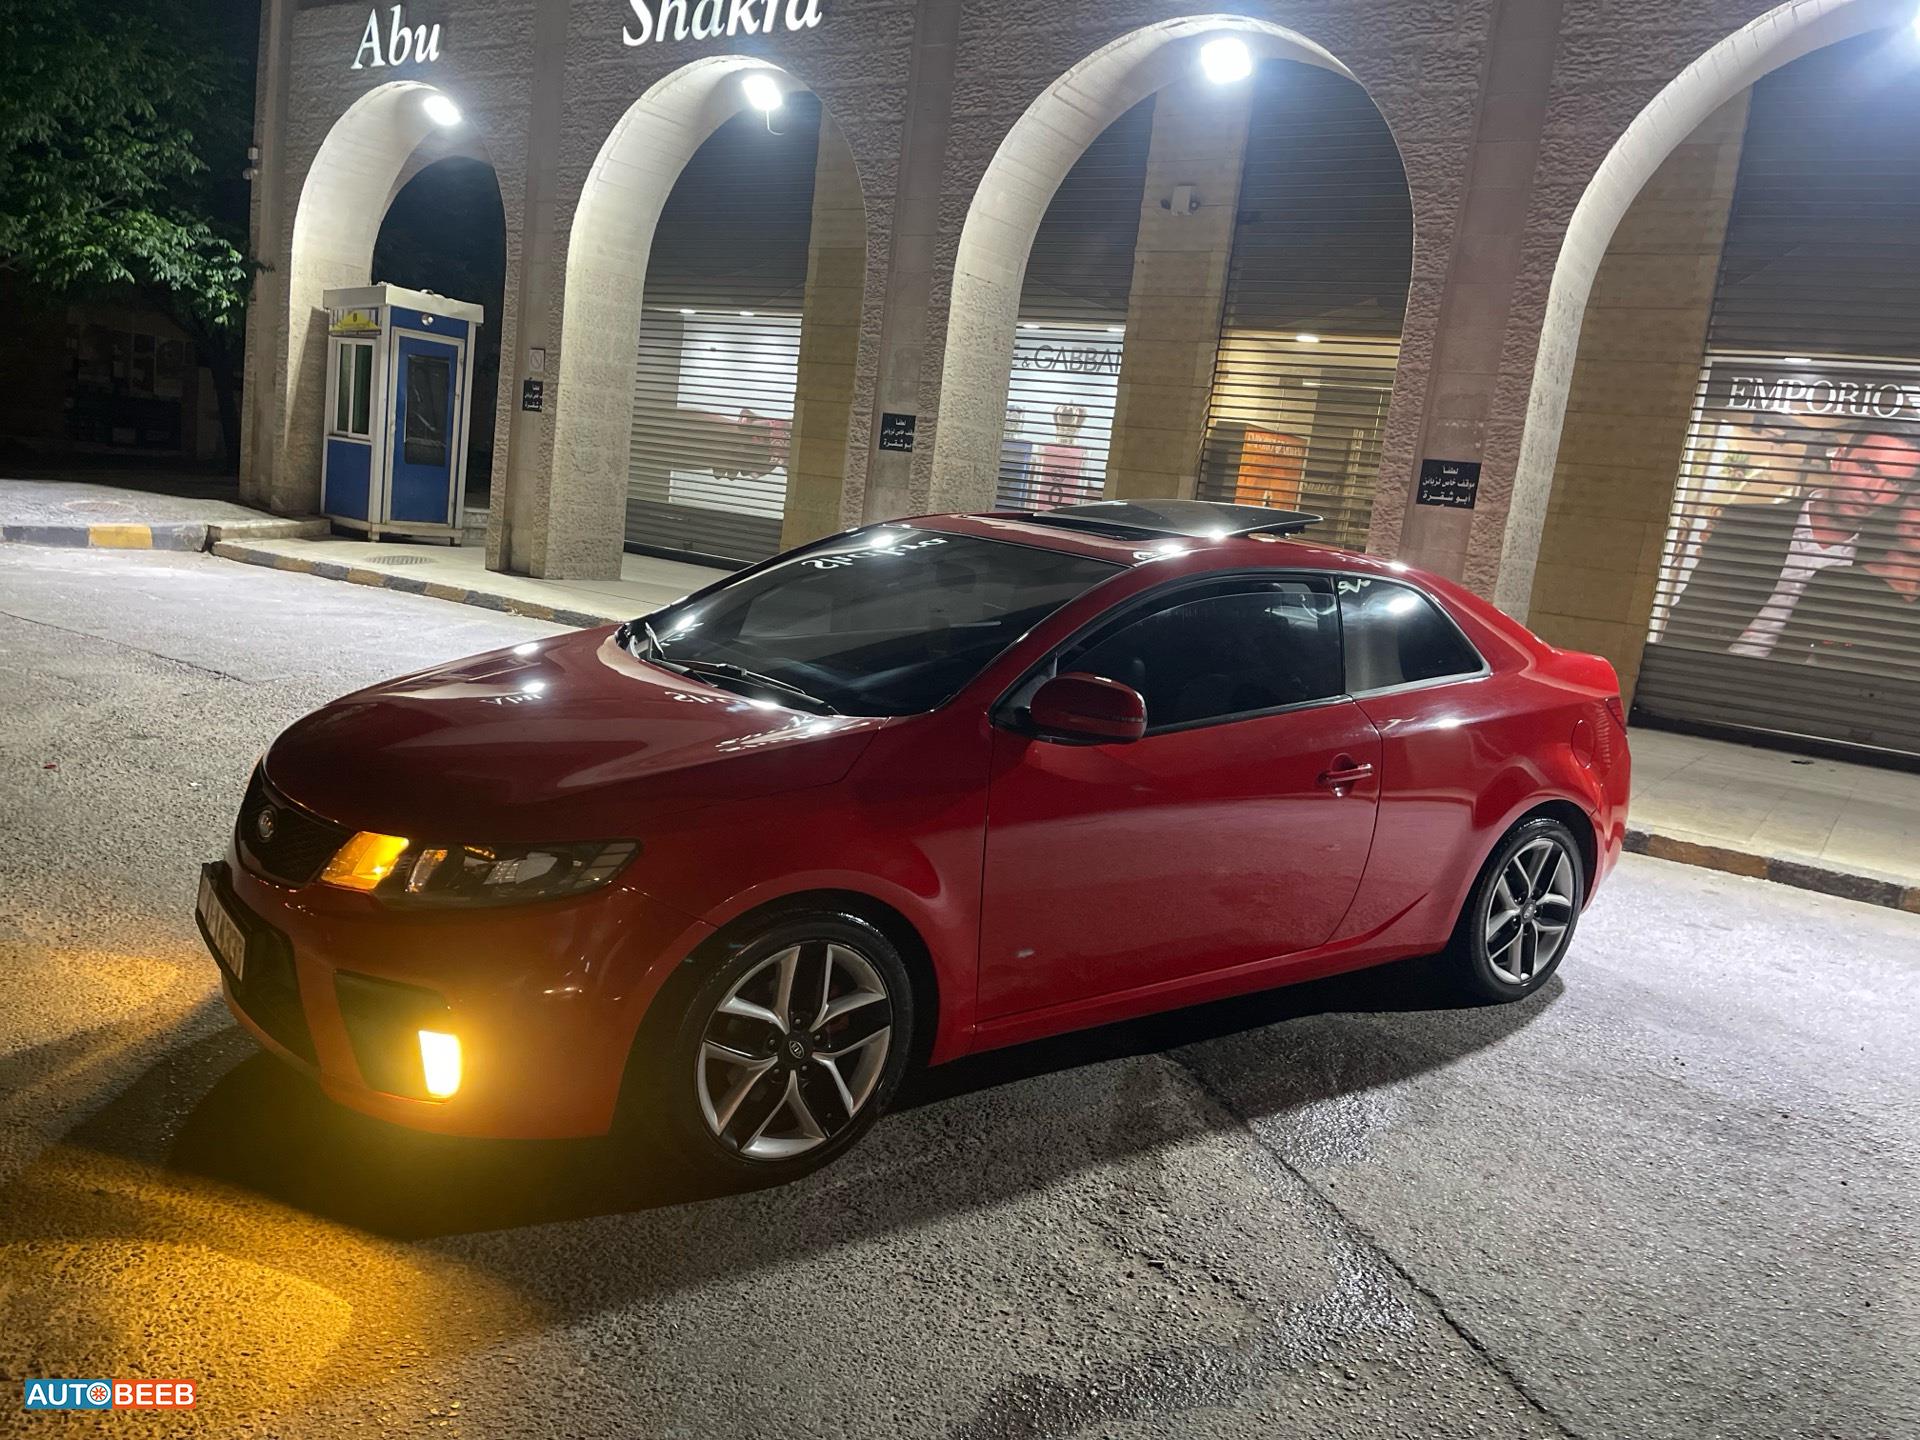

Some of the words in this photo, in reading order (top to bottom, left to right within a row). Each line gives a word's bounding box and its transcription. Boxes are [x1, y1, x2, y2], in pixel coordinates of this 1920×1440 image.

[350, 3, 440, 69] Abu
[1726, 376, 1904, 418] EMPORIO
[1422, 490, 1454, 502] شقرة
